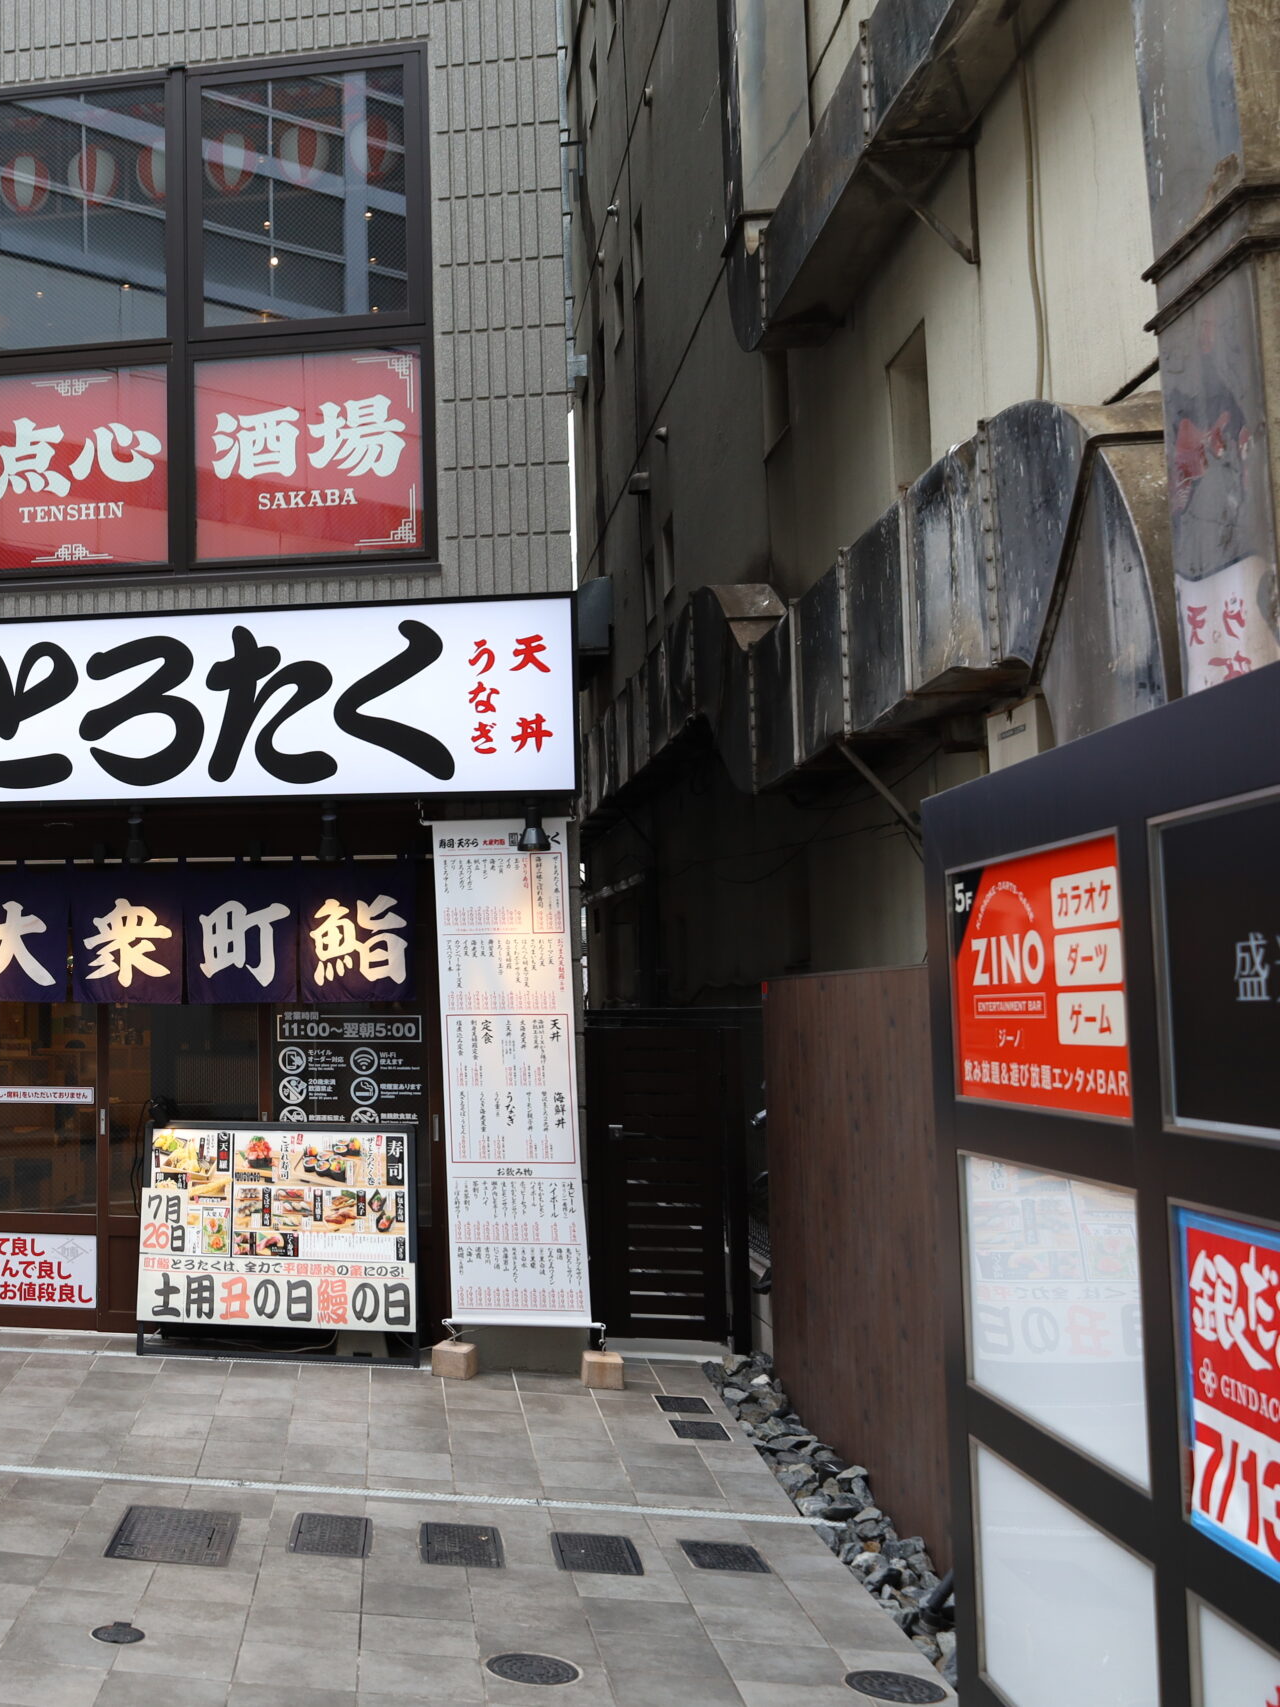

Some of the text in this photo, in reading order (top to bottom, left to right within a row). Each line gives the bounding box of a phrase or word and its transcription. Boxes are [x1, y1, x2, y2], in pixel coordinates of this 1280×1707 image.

[211, 394, 408, 480] 酒場
[19, 500, 125, 524] TENSHIN
[257, 487, 358, 510] SAKABA
[468, 639, 500, 755] うなぎ
[509, 634, 553, 754] 天丼
[954, 882, 974, 913] 5F
[1056, 878, 1113, 918] カラオケ
[971, 929, 1045, 986] ZINO
[1067, 942, 1109, 975] ダーツ
[284, 1011, 319, 1021] 営業時間
[977, 999, 1042, 1012] ENTERTAINMENT BAR
[1069, 1004, 1113, 1035] ゲーム
[481, 1019, 494, 1045] 定食
[550, 1018, 562, 1042] 天丼
[964, 1058, 1130, 1097] 飲み放題&遊び放題エンタメBAR
[505, 1091, 515, 1127] うなぎ
[554, 1091, 567, 1129] 海鮮丼
[280, 1135, 290, 1181] こぼれ寿司
[387, 1140, 404, 1181] 寿司
[497, 1167, 533, 1177] お飲み物
[147, 1194, 181, 1224] 7月
[549, 1182, 559, 1218] ハイボール
[143, 1222, 186, 1253] 26日
[0, 1281, 93, 1304] お値段良し
